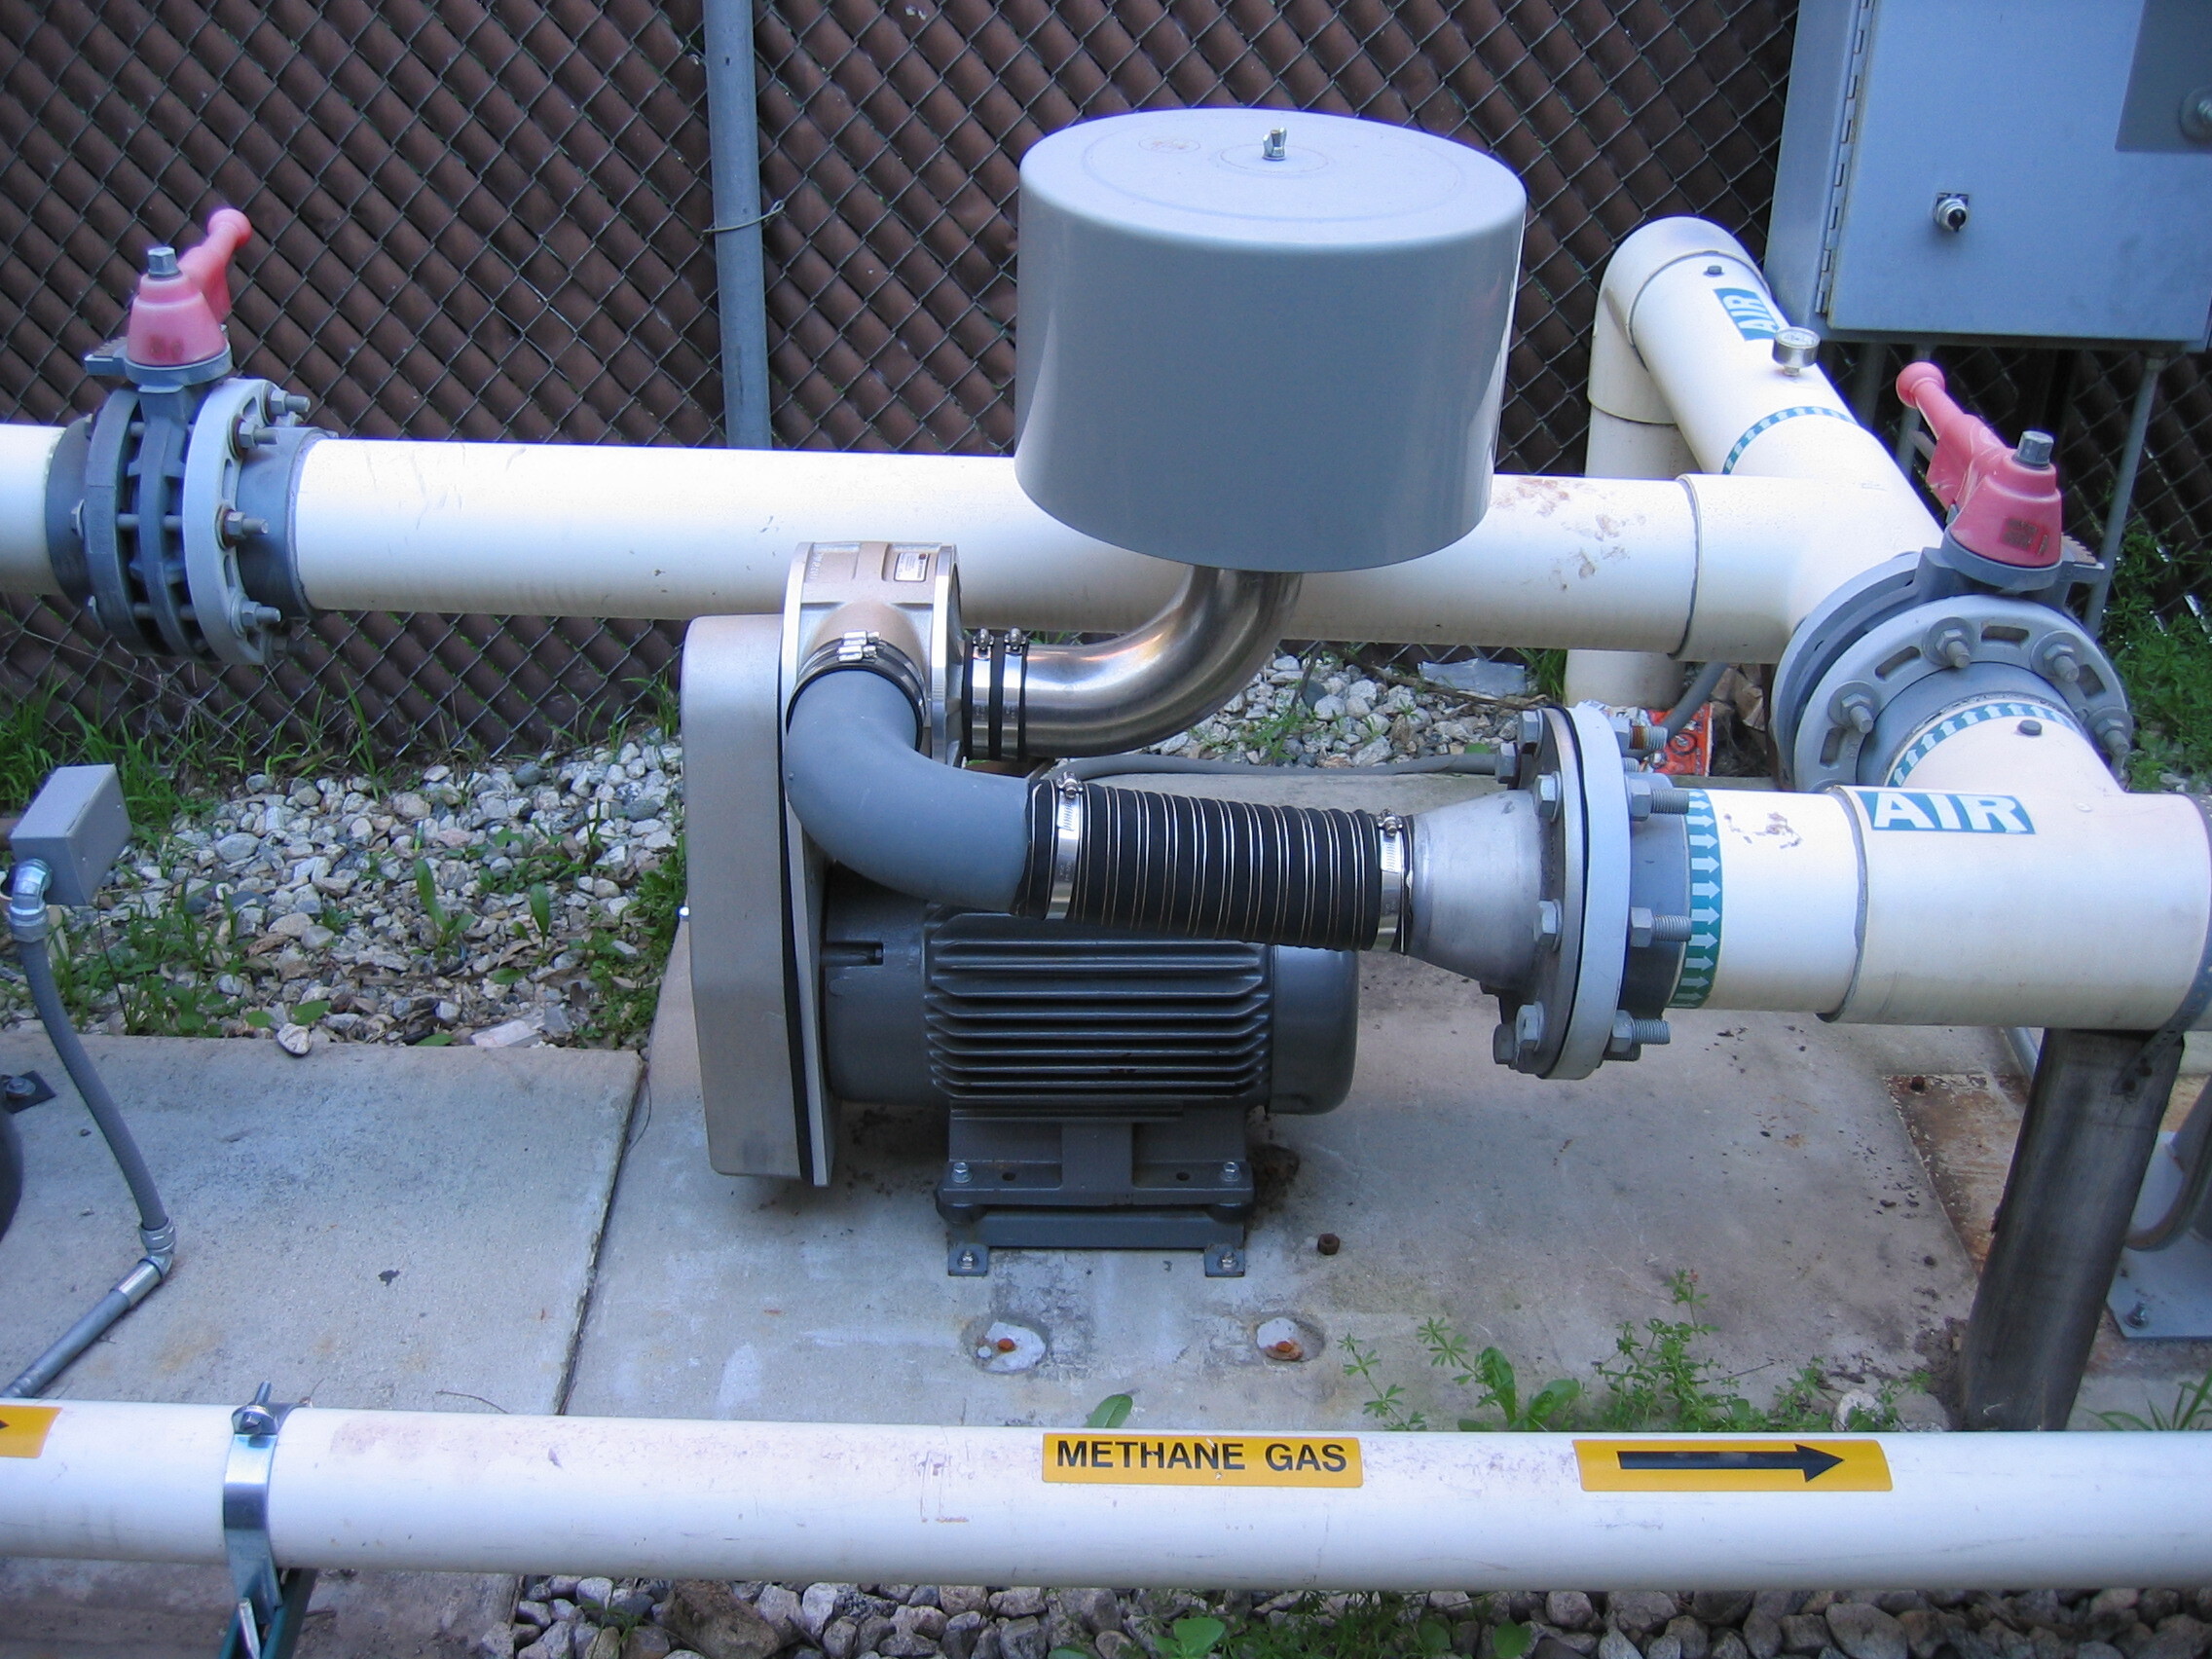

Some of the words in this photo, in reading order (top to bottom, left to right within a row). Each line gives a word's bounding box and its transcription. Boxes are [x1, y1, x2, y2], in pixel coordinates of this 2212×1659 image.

[1722, 294, 1779, 334] AIR
[1873, 793, 2028, 831] AIR
[1056, 1440, 1246, 1470] METHANE
[1265, 1443, 1347, 1473] GAS
